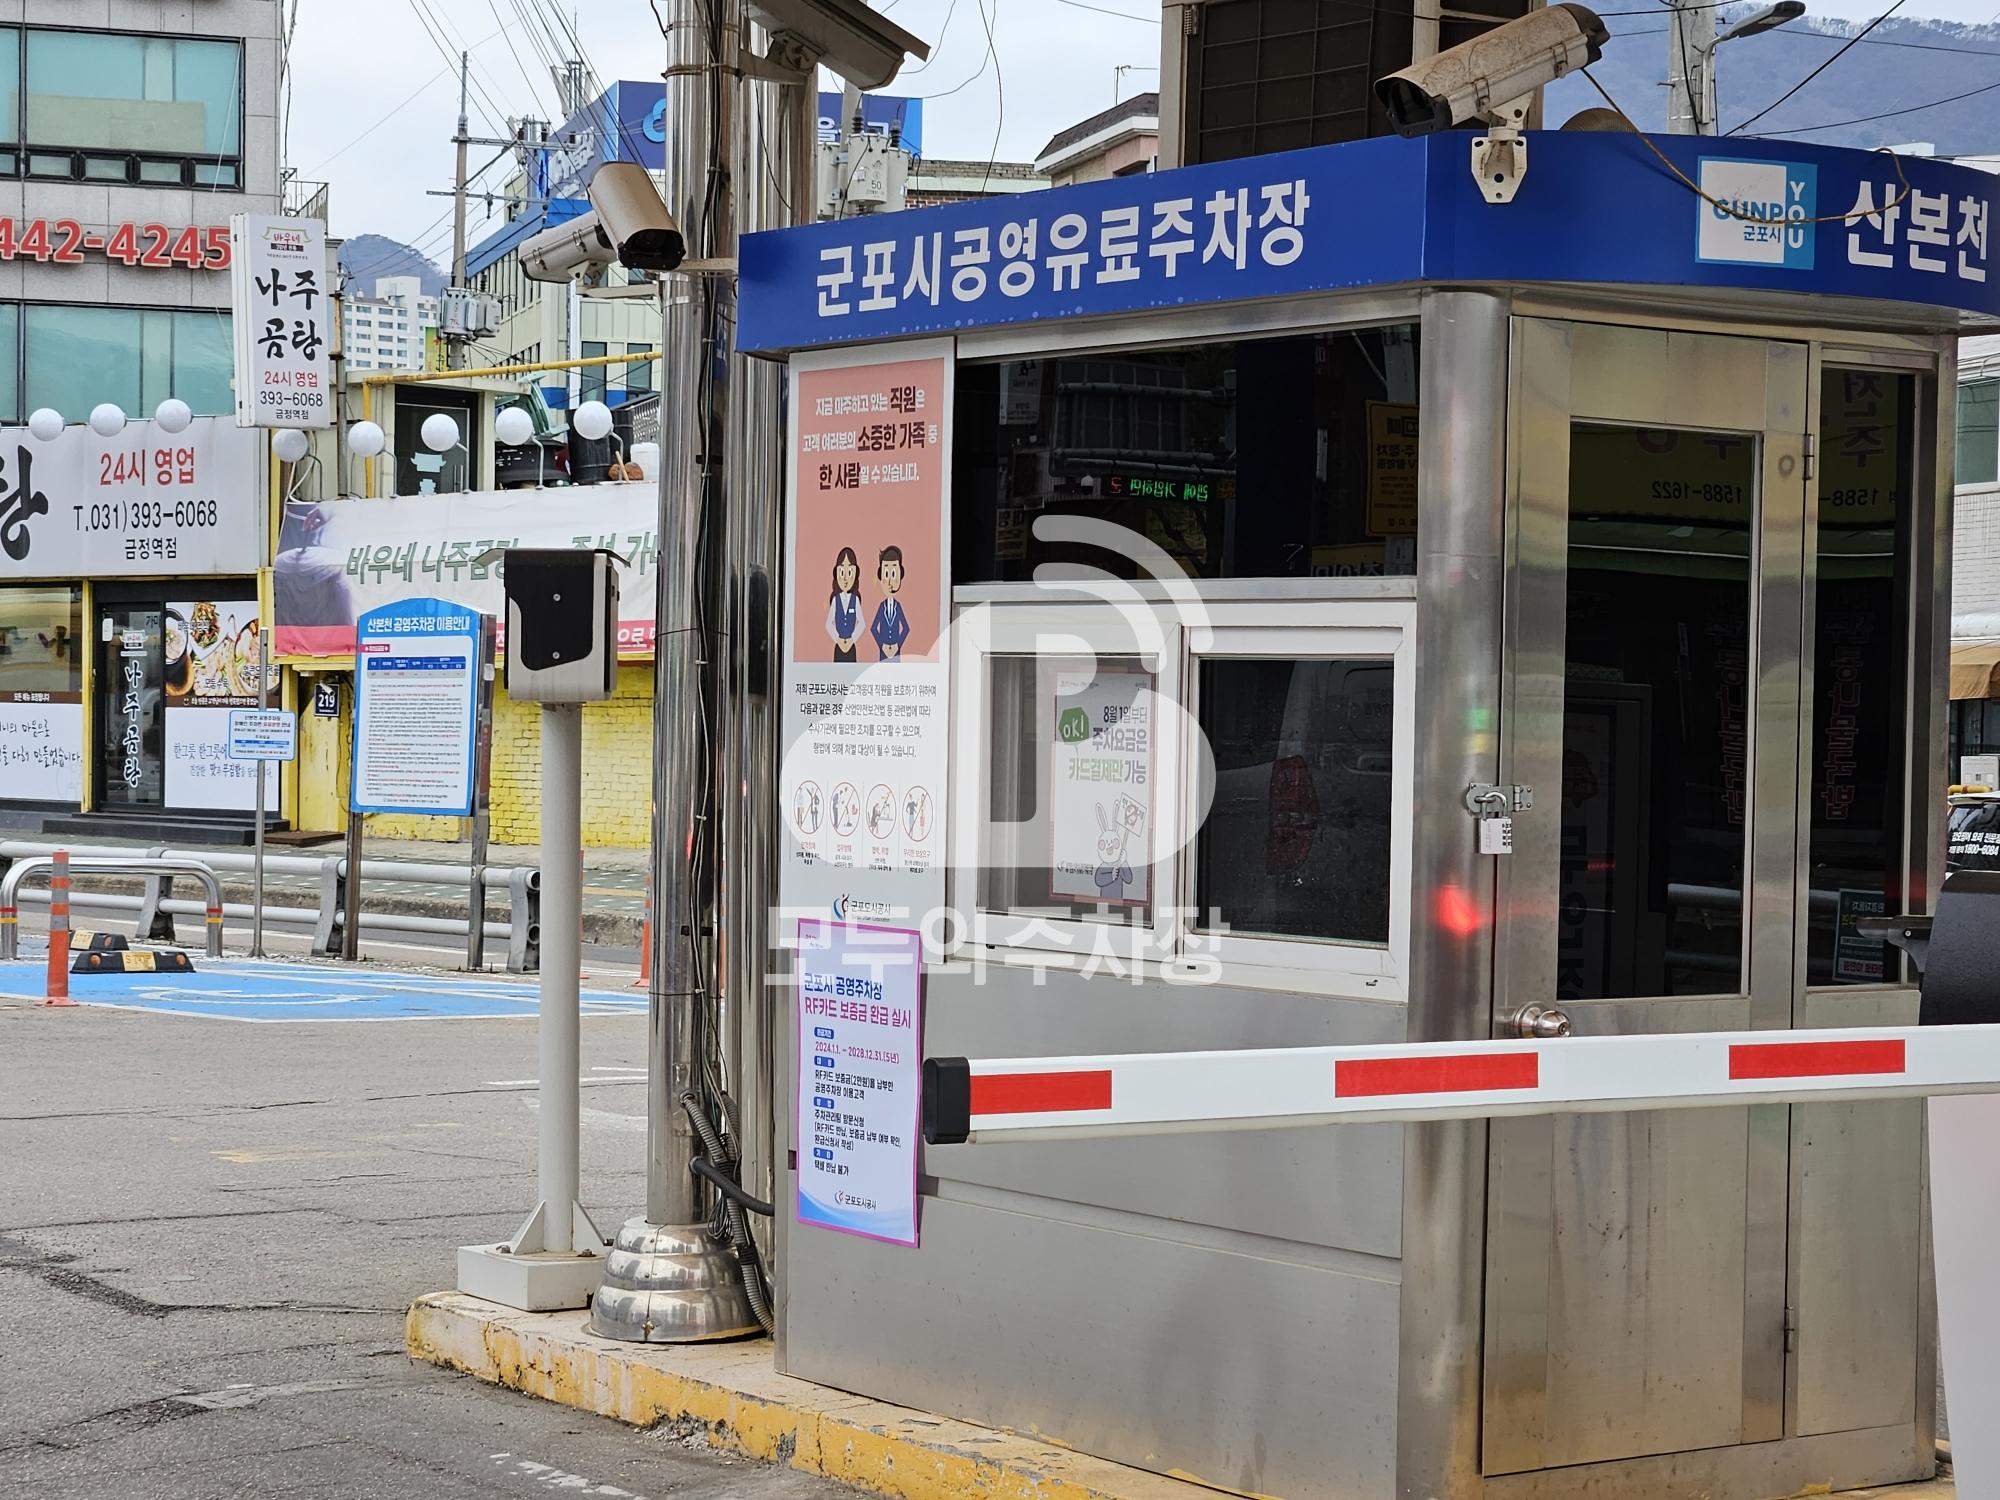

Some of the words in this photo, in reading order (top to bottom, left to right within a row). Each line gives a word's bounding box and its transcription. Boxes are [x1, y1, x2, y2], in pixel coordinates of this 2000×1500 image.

[871, 180, 882, 190] 50
[1744, 225, 1781, 243] 군포시
[1845, 180, 1989, 283] 산본천
[816, 180, 1311, 318] 군포시공영유료주차장
[255, 268, 320, 310] 나주
[258, 318, 323, 362] 곰탕
[264, 371, 292, 386] 24시
[295, 371, 318, 388] 영업
[260, 391, 324, 407] 393-6068
[815, 397, 833, 416] 지금
[870, 393, 888, 413] 있는
[890, 386, 925, 413] 직원은
[275, 409, 309, 420] 금정역점
[803, 433, 820, 452] 고객
[822, 431, 856, 452] 여러분의
[858, 424, 897, 452] 소중한
[899, 421, 926, 449] 가족
[928, 424, 938, 444] 중
[100, 449, 146, 486] 24시
[155, 447, 195, 486] 영업
[819, 463, 833, 490] 한
[834, 462, 870, 489] 사람일
[871, 467, 881, 484] 수
[882, 463, 920, 484] 있습니다.
[73, 500, 218, 532] T.031)393-6068
[125, 537, 177, 559] 금정역점
[346, 541, 418, 585] 바우네
[367, 618, 393, 633] 산본천
[393, 617, 436, 632] 공영주차장
[436, 615, 471, 632] 이용안내
[318, 693, 335, 707] 219
[808, 683, 849, 696] 군포도시공사는
[849, 684, 874, 697] 고객응대
[874, 684, 892, 697] 직원을
[893, 684, 917, 697] 보호하기
[918, 684, 937, 698] 위하여
[800, 702, 818, 715] 다음과
[819, 702, 831, 715] 같은
[832, 703, 844, 716] 경우
[886, 704, 893, 717] 등
[918, 705, 931, 717] 따라
[1103, 705, 1118, 724] 8월
[1119, 705, 1148, 724] 1일부터
[122, 660, 143, 788] 나주곰탕
[838, 723, 856, 736] 필요한
[895, 725, 901, 736] 수
[1092, 727, 1148, 752] 주차요금은
[174, 742, 196, 760] 한그릇
[1068, 757, 1123, 782] 카드결제만
[1124, 759, 1148, 785] 가능
[851, 900, 892, 916] 군포도시공사
[804, 972, 833, 994] 군포시
[835, 976, 883, 1001] 공영주차장
[805, 996, 837, 1018] RF카드
[840, 1000, 867, 1023] 보증금
[870, 1005, 889, 1026] 환급
[892, 1008, 912, 1029] 실시
[815, 1069, 834, 1082] RF카드
[815, 1082, 841, 1097] 공영주차장
[842, 1086, 865, 1100] 이용고객
[826, 1162, 836, 1174] 반납
[837, 1164, 849, 1177] 불가
[845, 1195, 877, 1211] 군포도시공사
